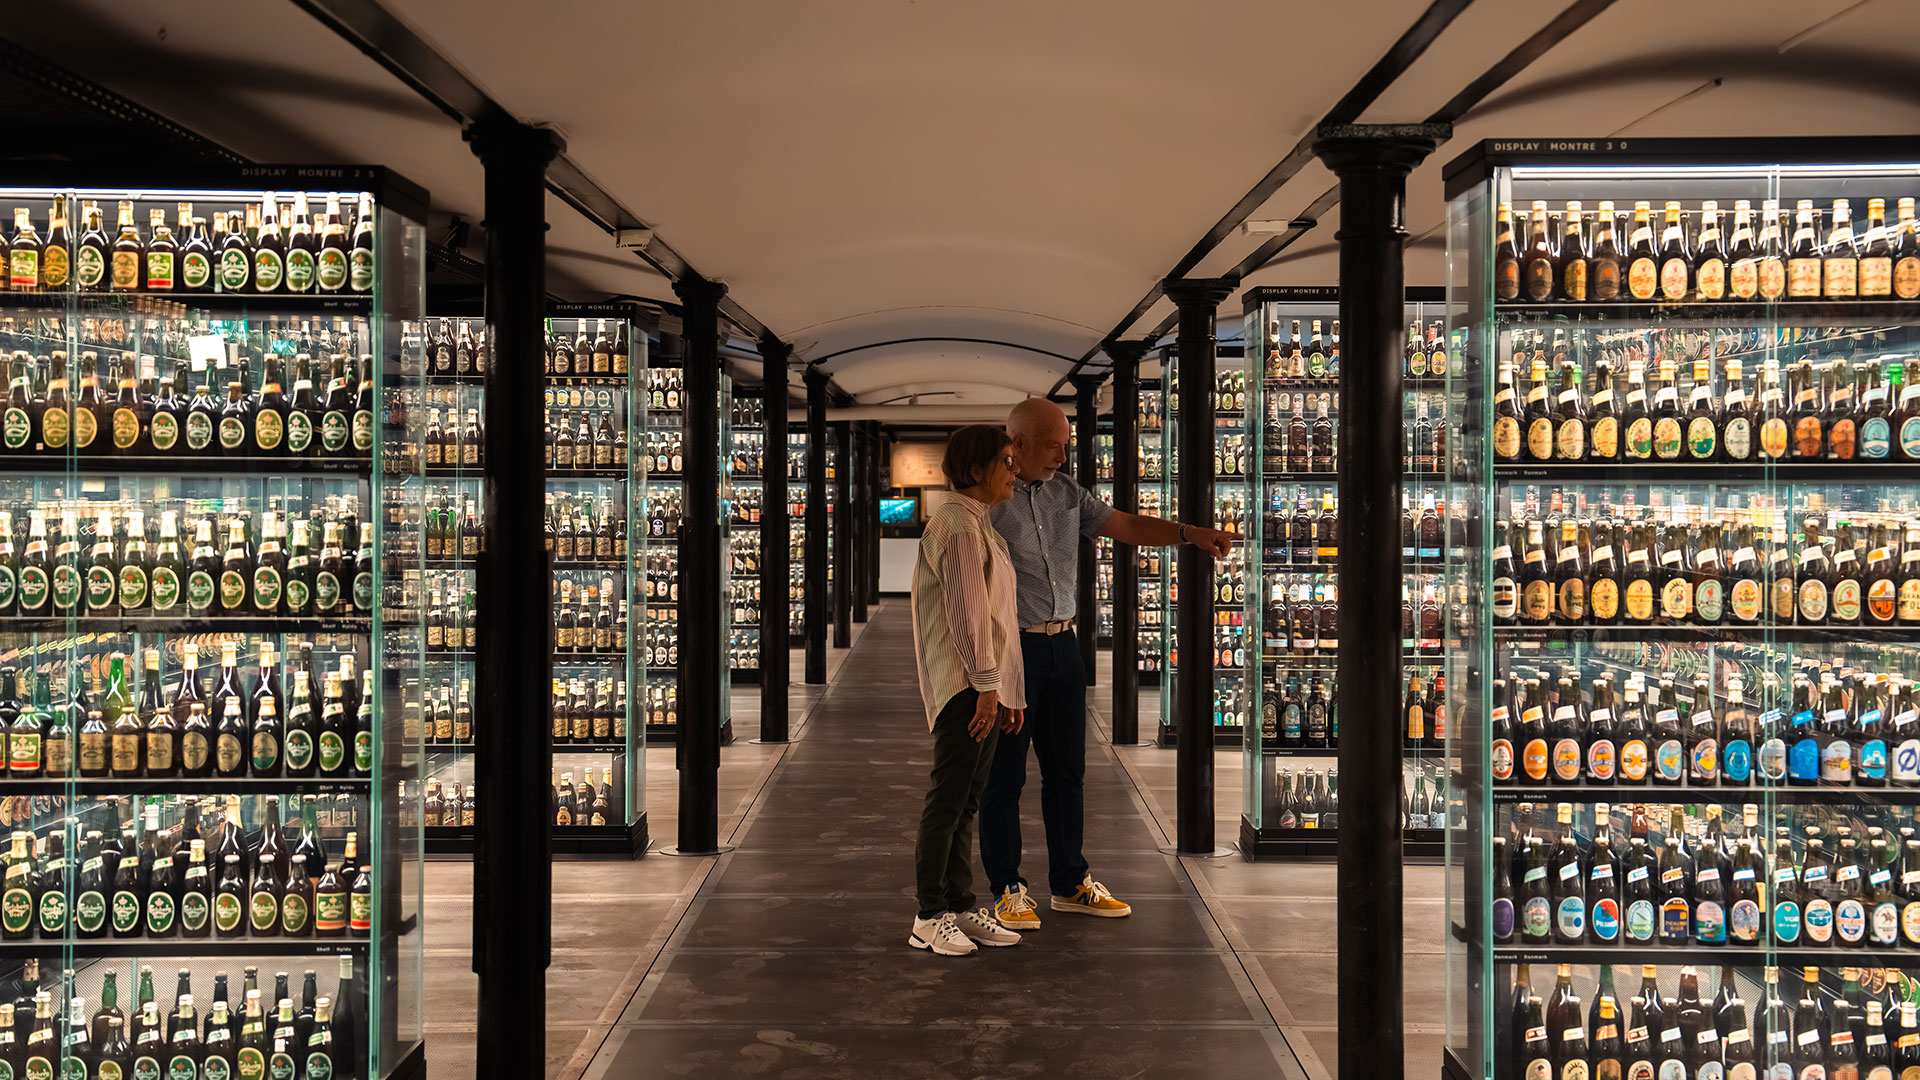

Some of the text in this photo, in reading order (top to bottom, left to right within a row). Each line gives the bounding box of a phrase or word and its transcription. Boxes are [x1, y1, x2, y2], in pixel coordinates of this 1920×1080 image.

[1494, 142, 1540, 151] DISPLAY
[1549, 142, 1596, 151] MONTRE
[242, 167, 287, 177] DISPLAY
[297, 168, 344, 178] MONTRE
